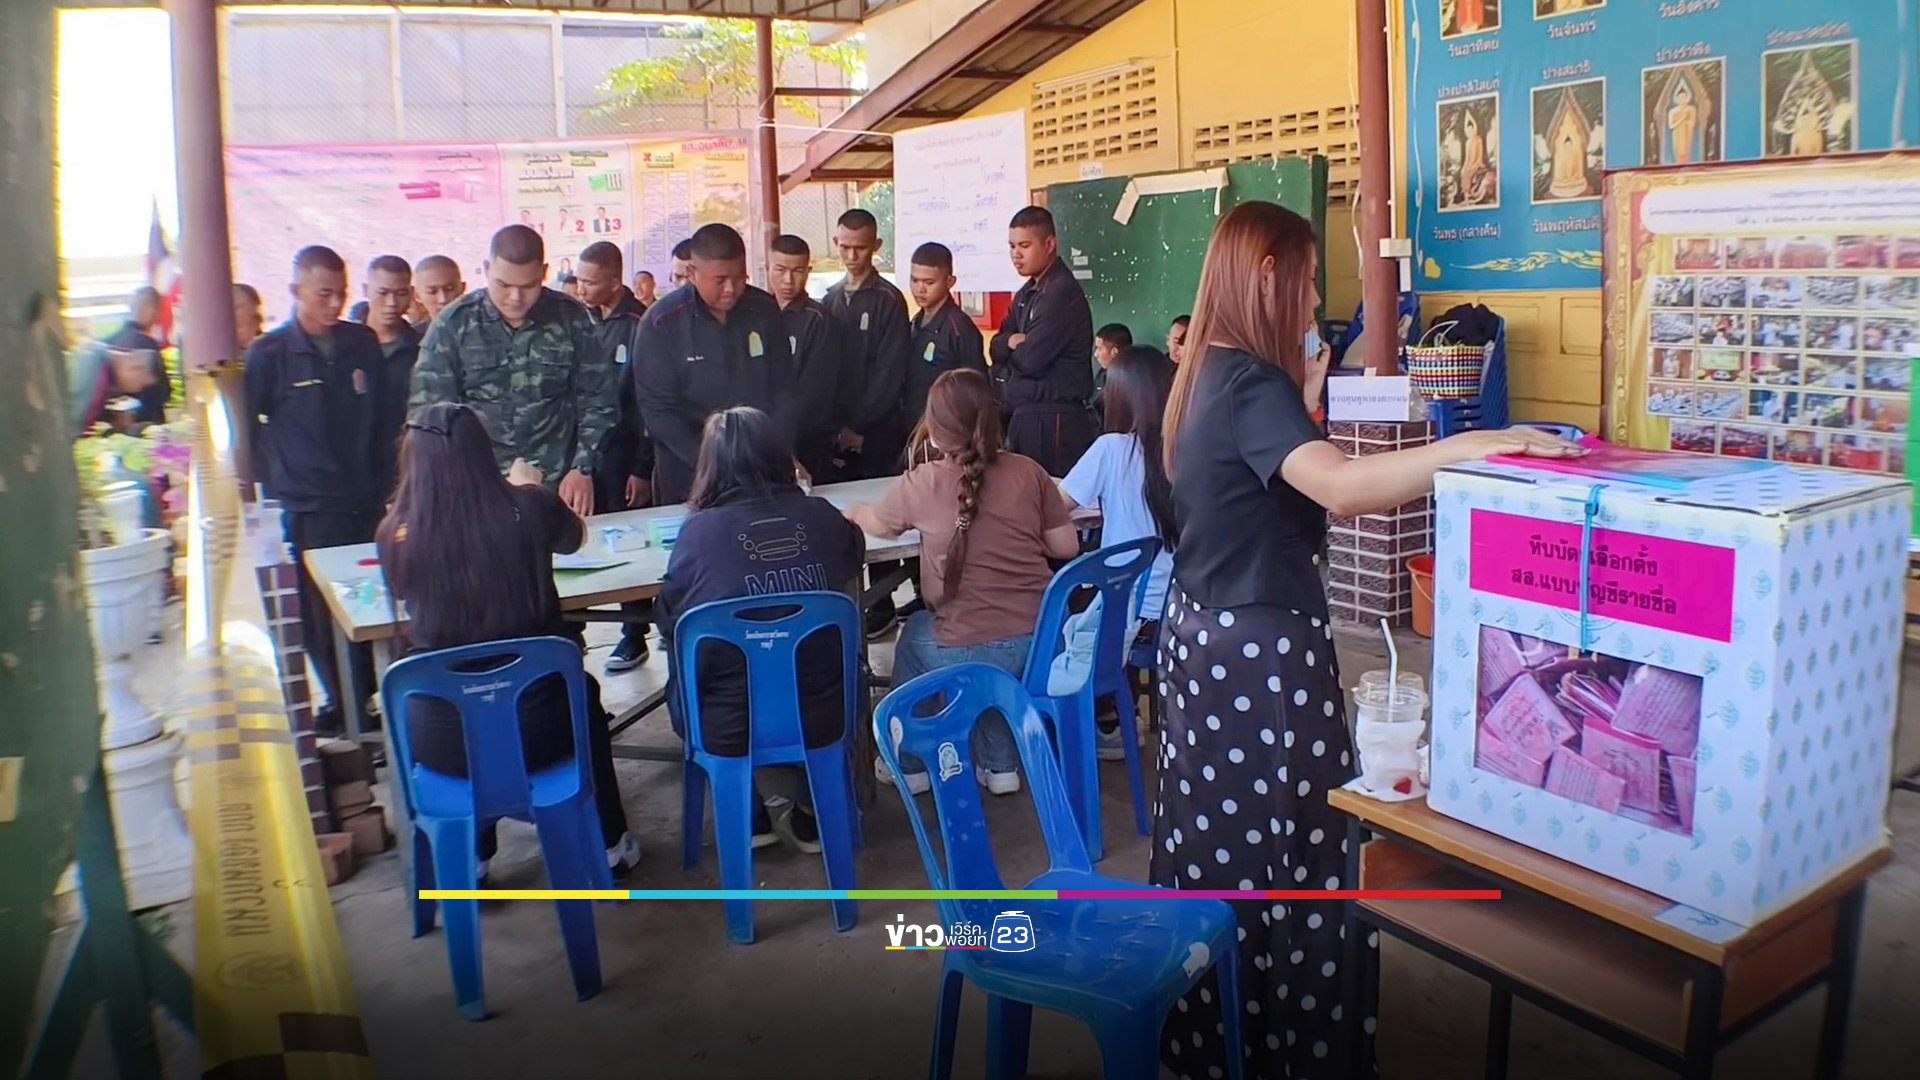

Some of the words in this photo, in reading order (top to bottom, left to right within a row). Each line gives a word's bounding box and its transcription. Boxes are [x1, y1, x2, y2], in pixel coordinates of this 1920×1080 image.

[1547, 11, 1597, 39] วันจันทร์
[1448, 31, 1500, 58] วันอาทิตย์
[1529, 534, 1658, 577] หีบบัตเลือกตั้ง
[744, 563, 828, 596] MINI
